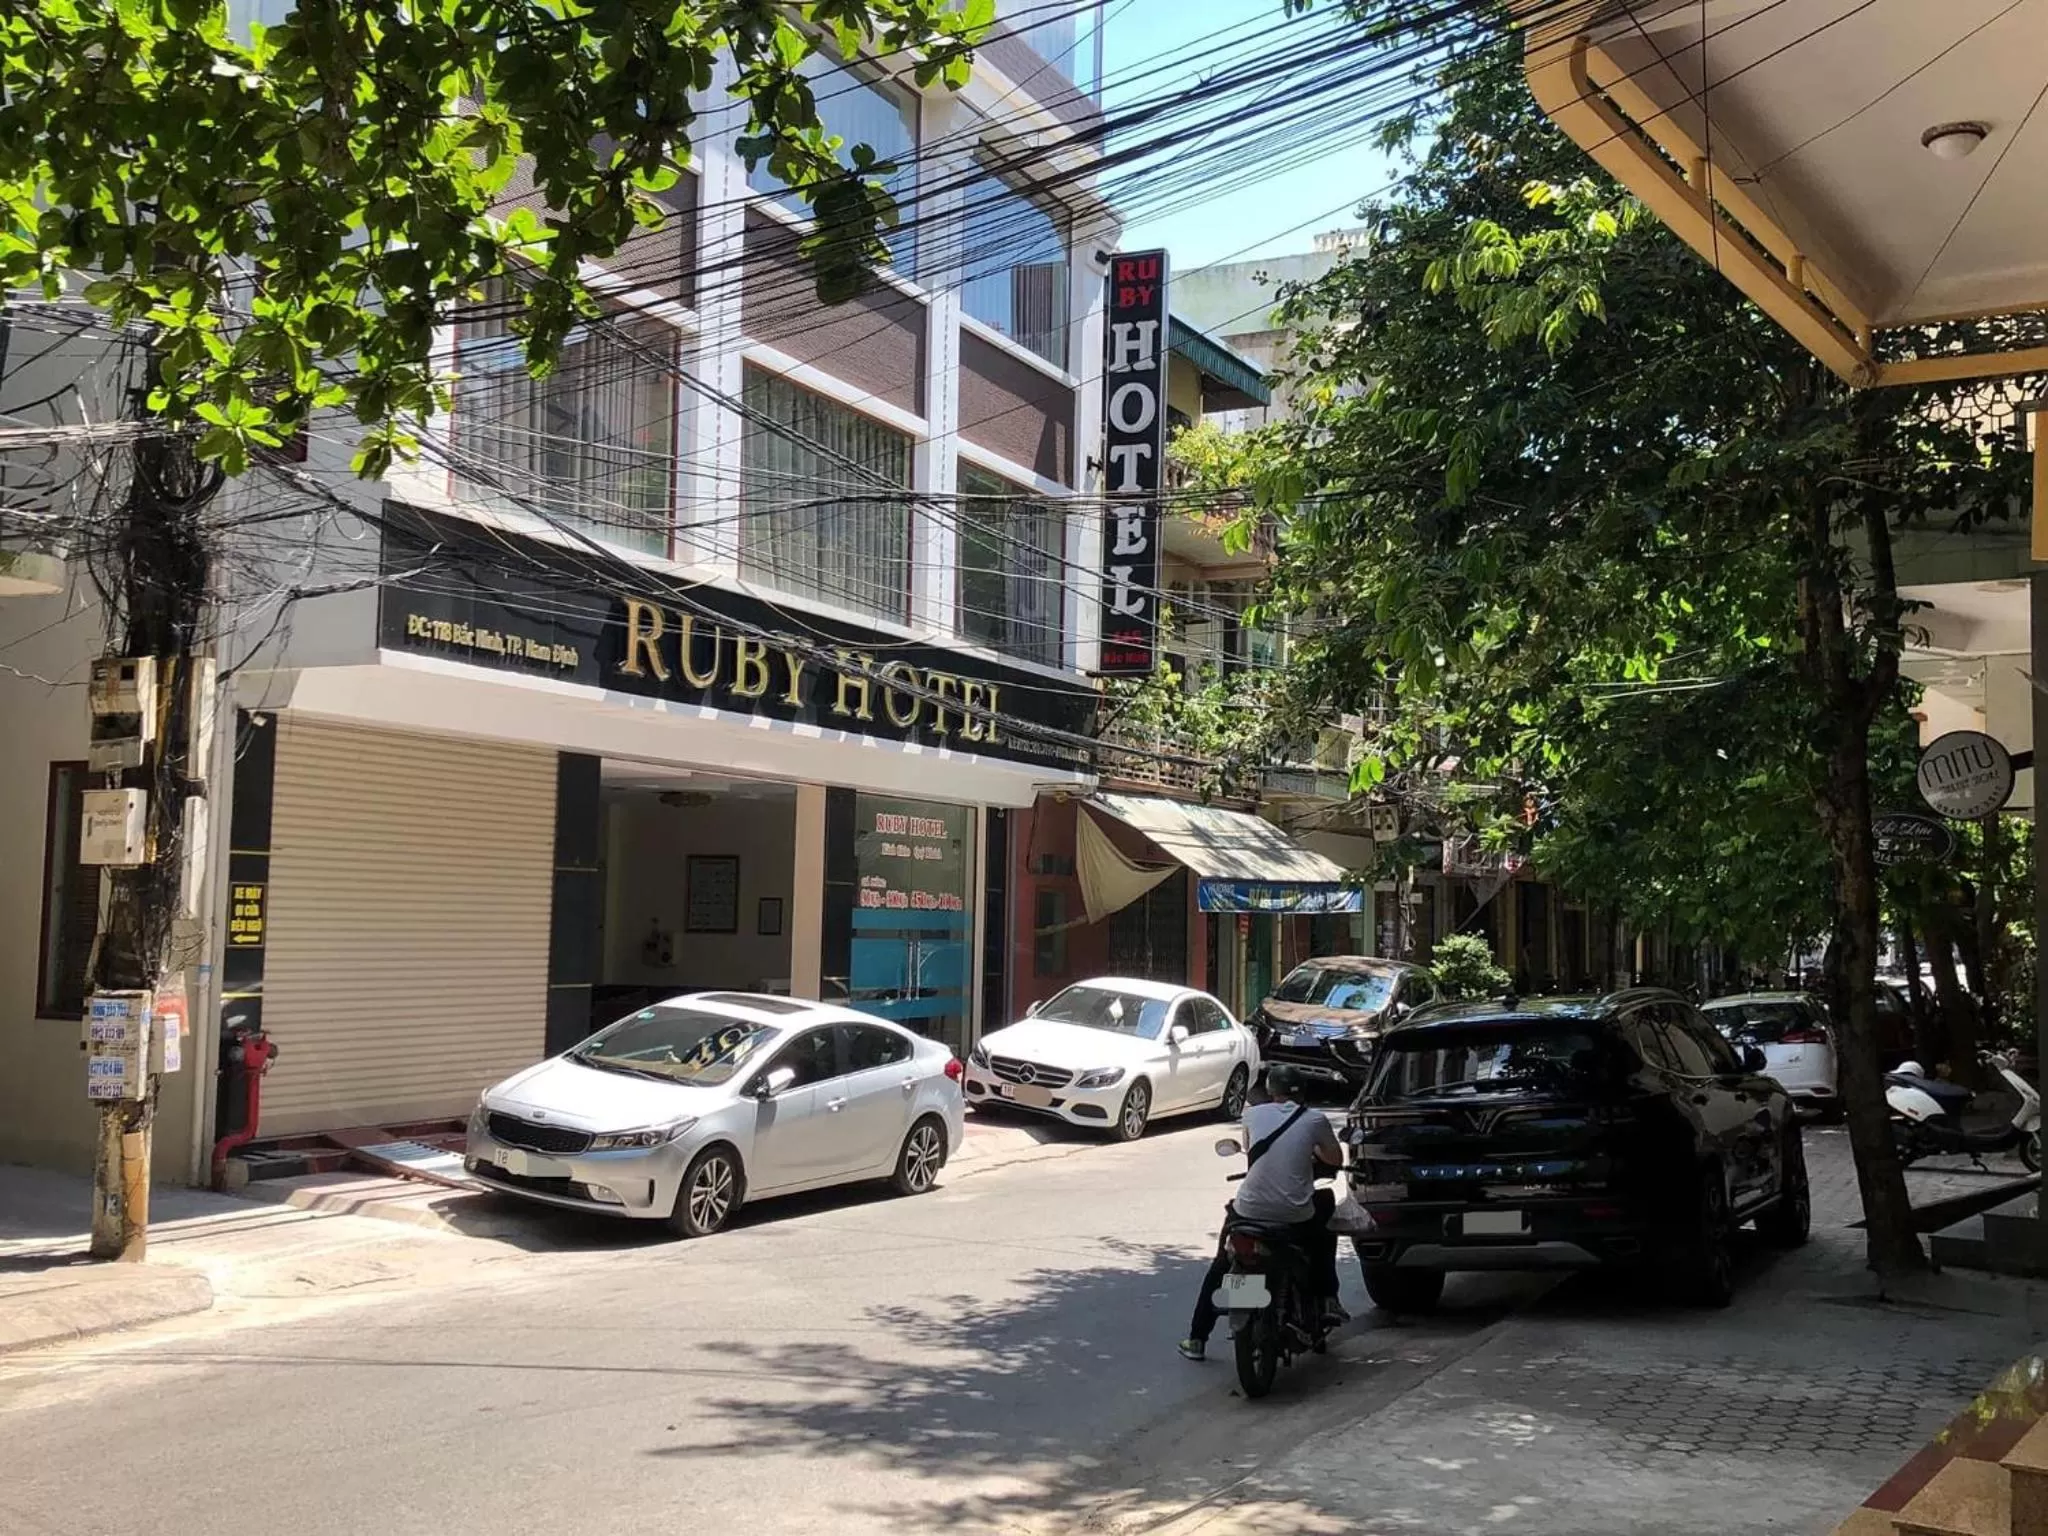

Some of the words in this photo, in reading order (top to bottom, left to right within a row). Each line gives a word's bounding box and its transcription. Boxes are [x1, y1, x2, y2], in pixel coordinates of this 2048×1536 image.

[1108, 320, 1160, 617] HOTEL
[617, 598, 805, 708] RUBY
[831, 649, 1007, 746] HOTEL
[876, 813, 907, 835] RUBY
[909, 816, 948, 839] HOTEL
